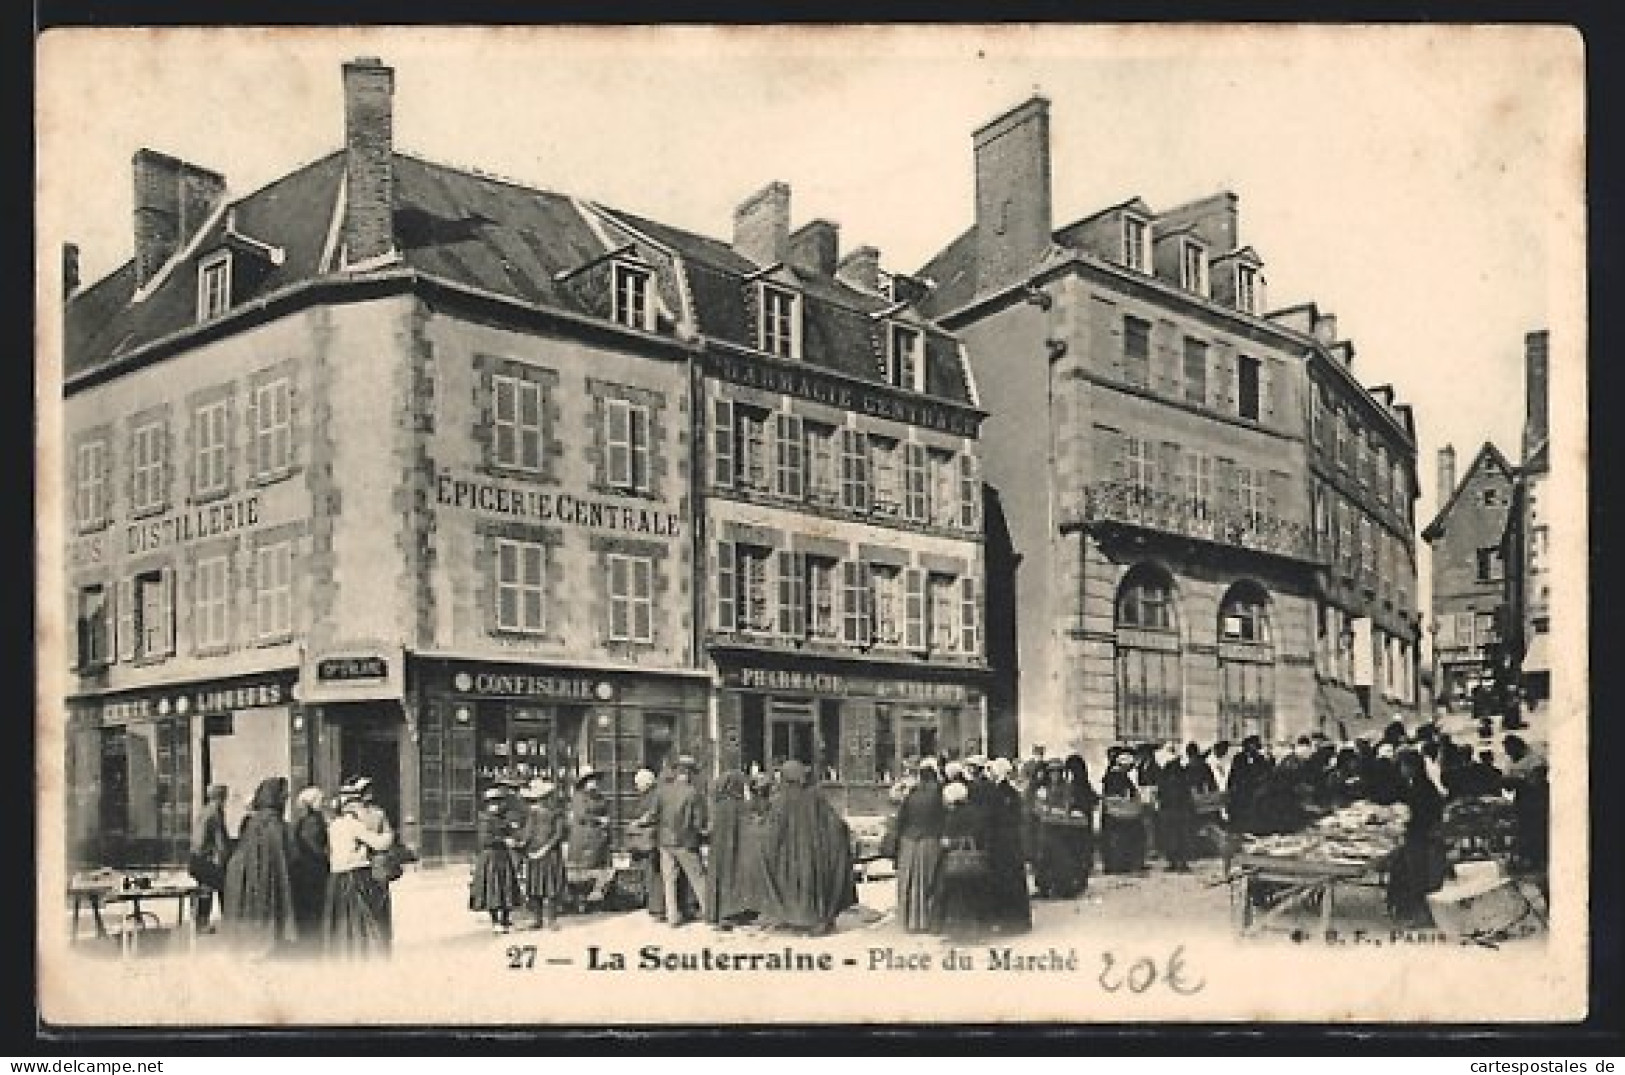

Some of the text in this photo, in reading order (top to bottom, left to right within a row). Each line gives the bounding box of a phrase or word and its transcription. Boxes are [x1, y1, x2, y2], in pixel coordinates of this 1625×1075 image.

[126, 496, 259, 554] DISTILLERIE
[556, 494, 681, 537] CENTRALE
[474, 672, 594, 699] CONFISERIE
